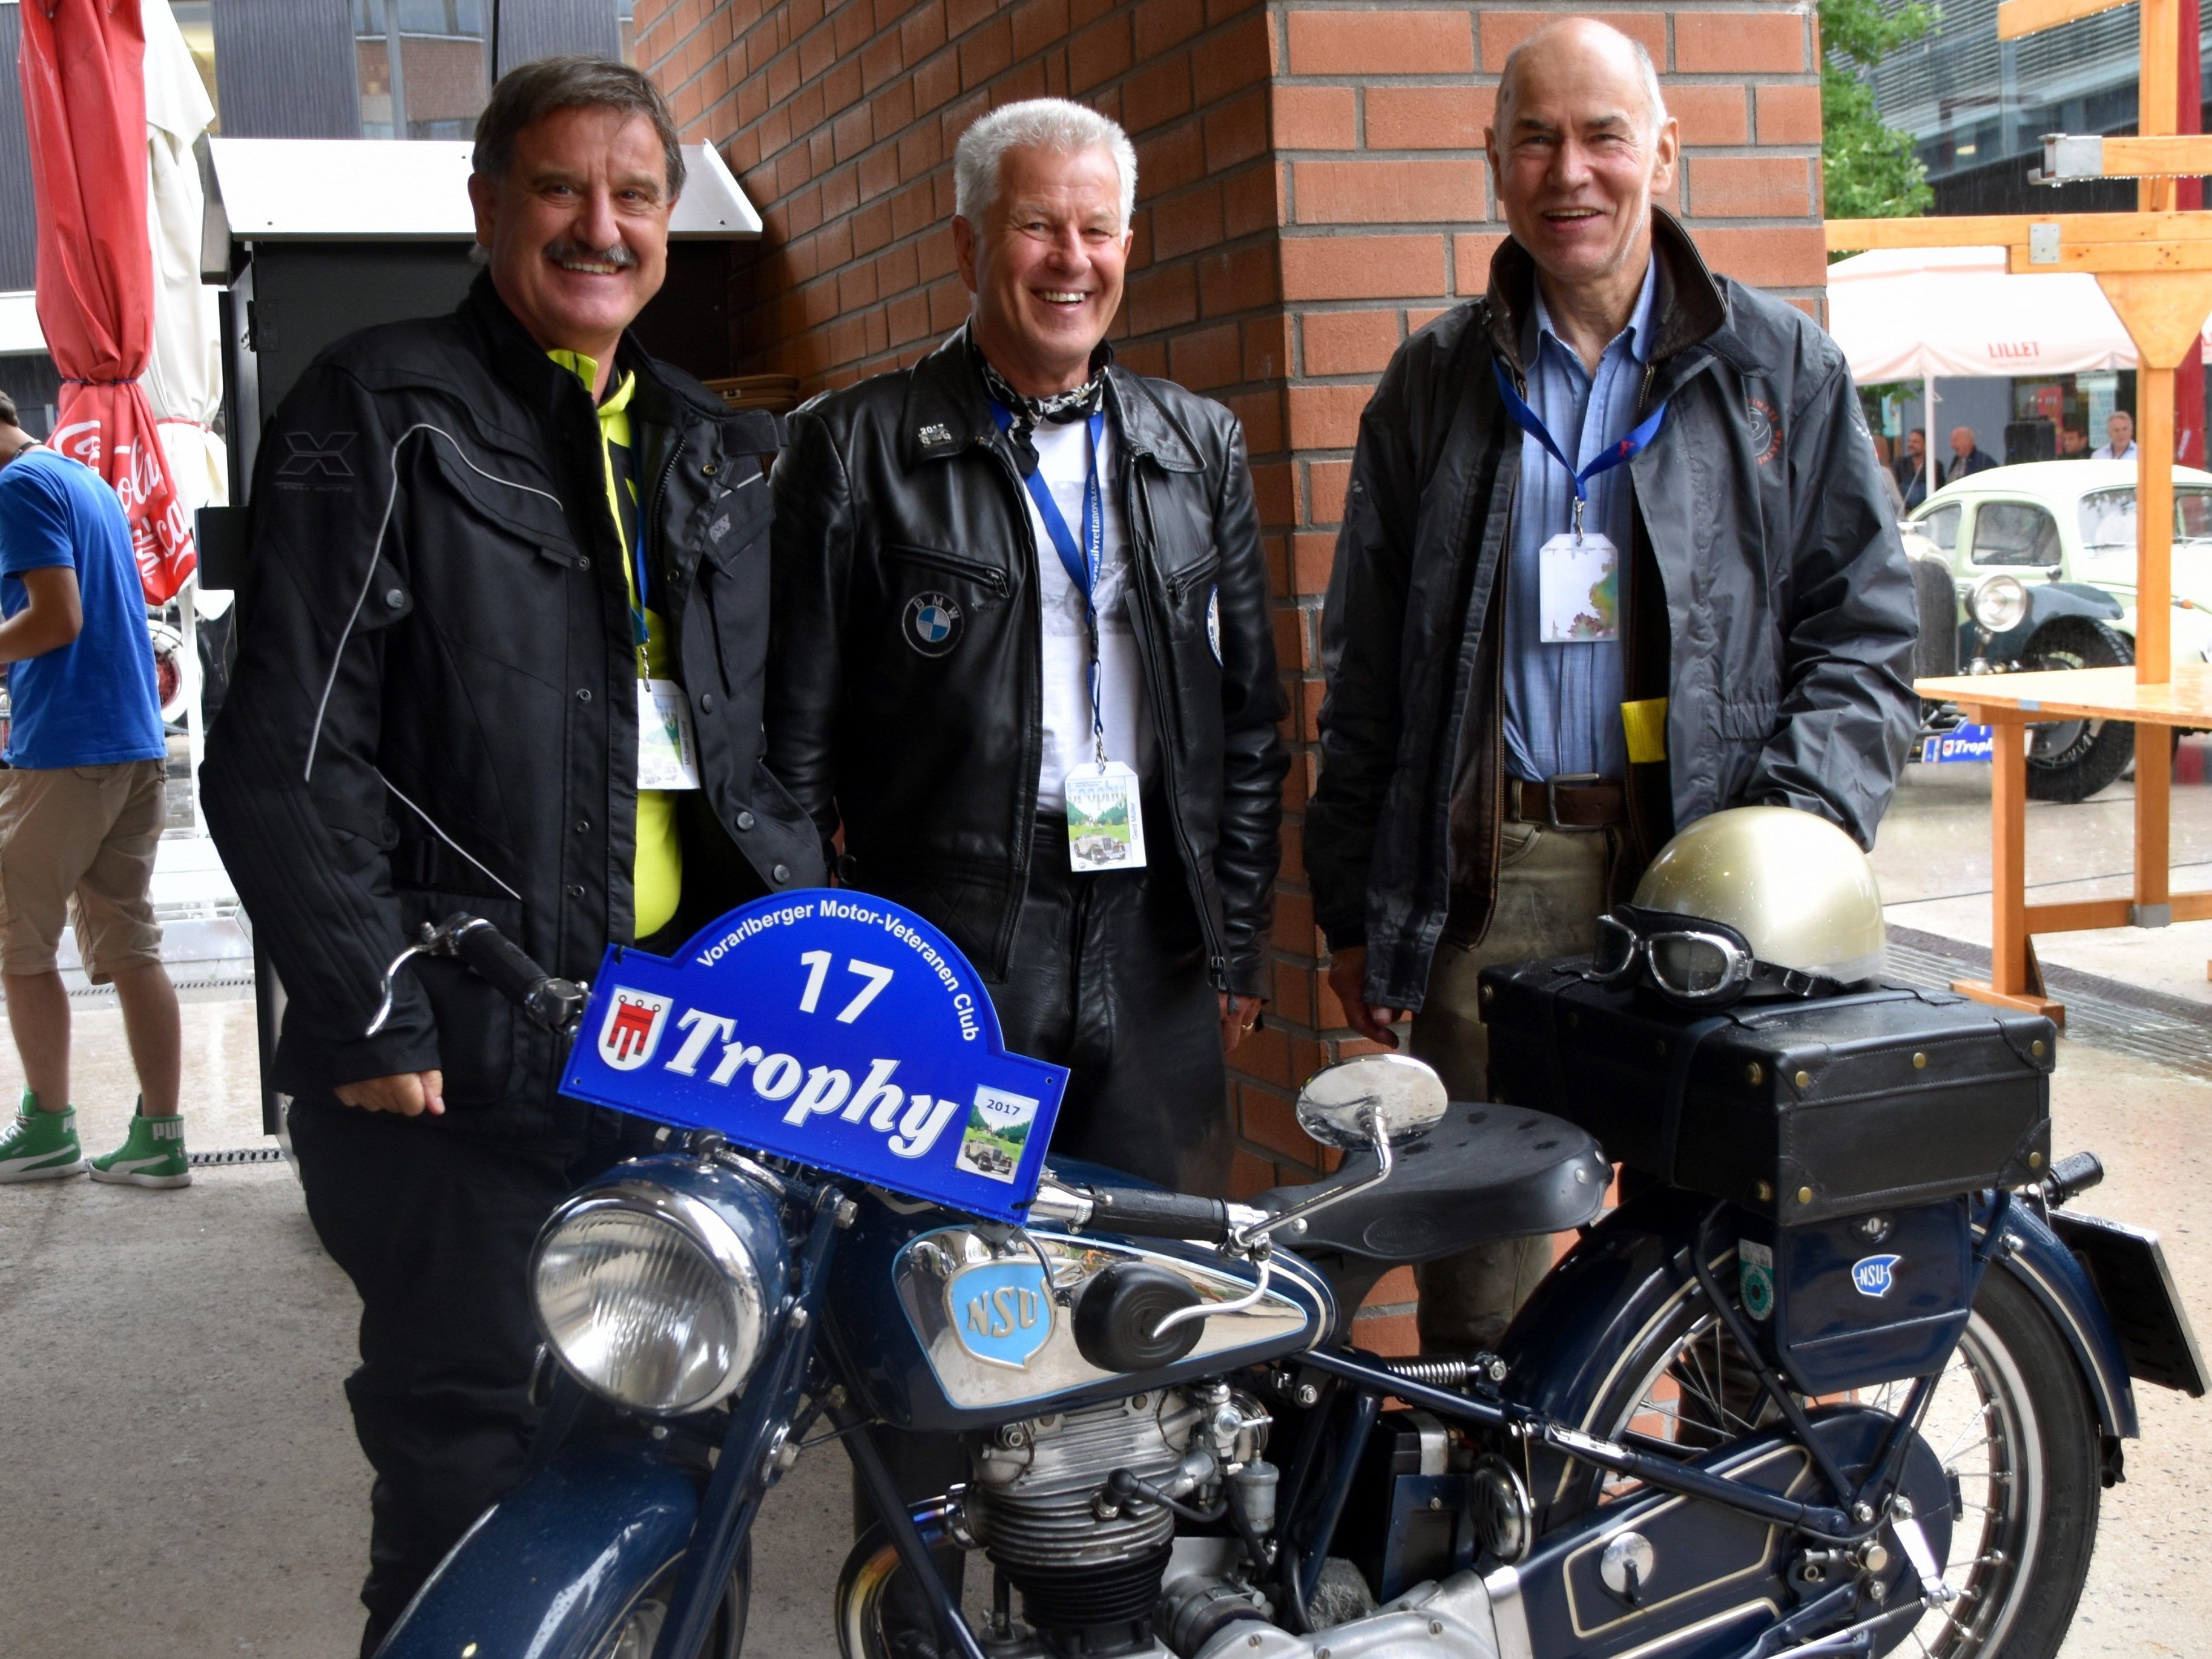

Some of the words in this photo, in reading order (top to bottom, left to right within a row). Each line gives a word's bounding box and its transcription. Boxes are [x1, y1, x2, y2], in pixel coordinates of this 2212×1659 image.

[1988, 342, 2039, 358] LILLET
[913, 594, 960, 620] BMW
[697, 902, 814, 968] Vorarlberger
[819, 899, 960, 994] Motor-Veteranen
[953, 993, 978, 1042] Club
[799, 950, 894, 1024] 17
[663, 1008, 960, 1158] Trophy
[986, 1097, 1021, 1116] 2017
[1860, 1264, 1884, 1286] NSU
[967, 1286, 1039, 1338] NSU
